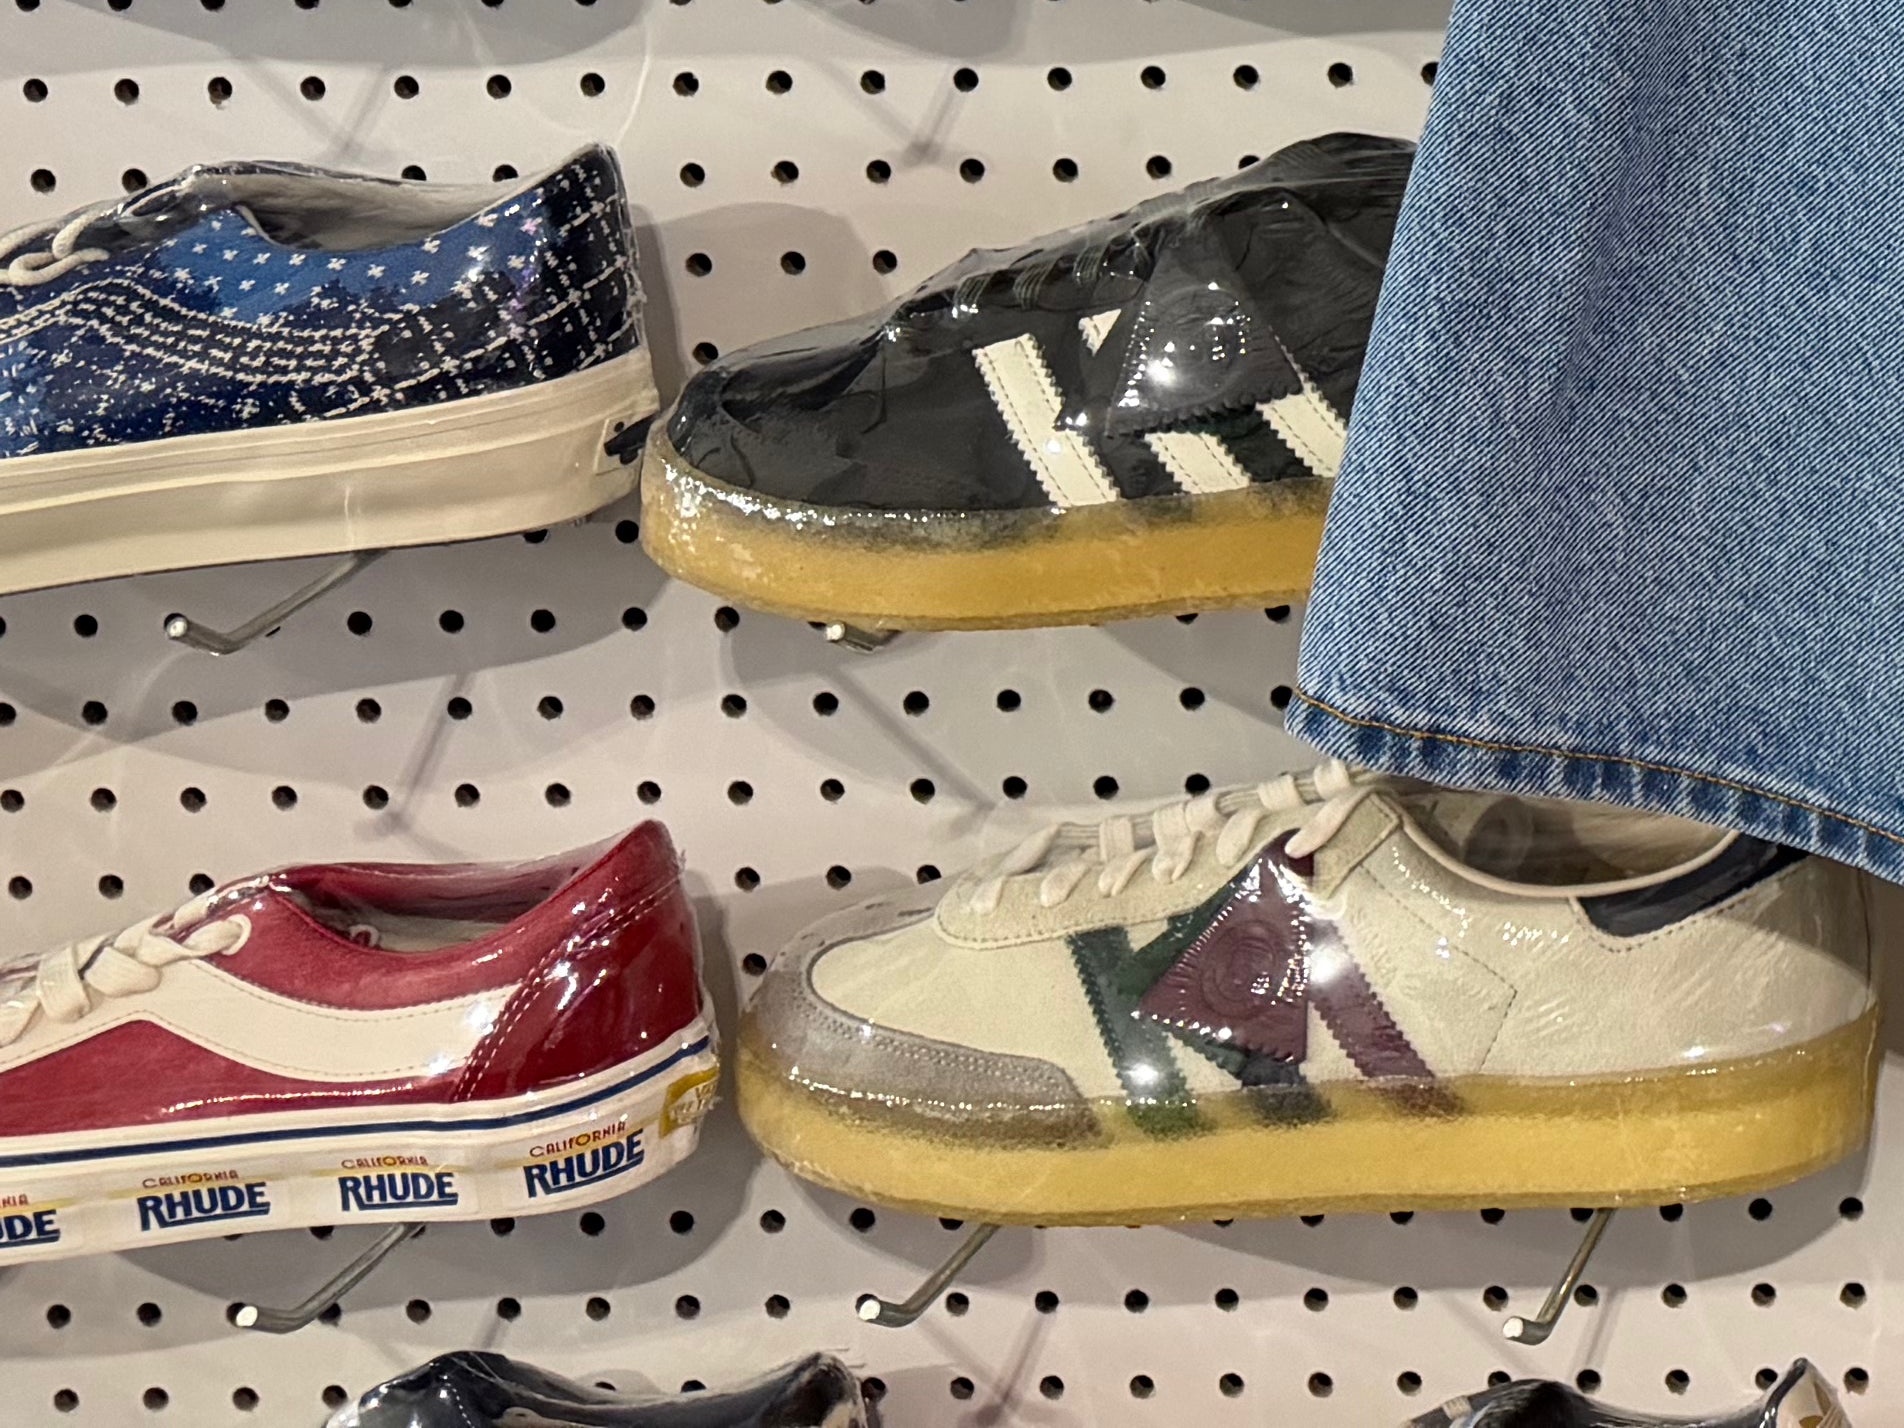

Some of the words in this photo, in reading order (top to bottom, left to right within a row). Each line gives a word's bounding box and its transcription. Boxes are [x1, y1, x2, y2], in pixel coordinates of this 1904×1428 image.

[529, 1121, 627, 1158] CALIFORNIA
[142, 1170, 239, 1189] CALIFORNIA
[523, 1128, 645, 1198] RHUDE
[136, 1181, 271, 1232] RHUDE
[338, 1172, 458, 1212] RHUDE
